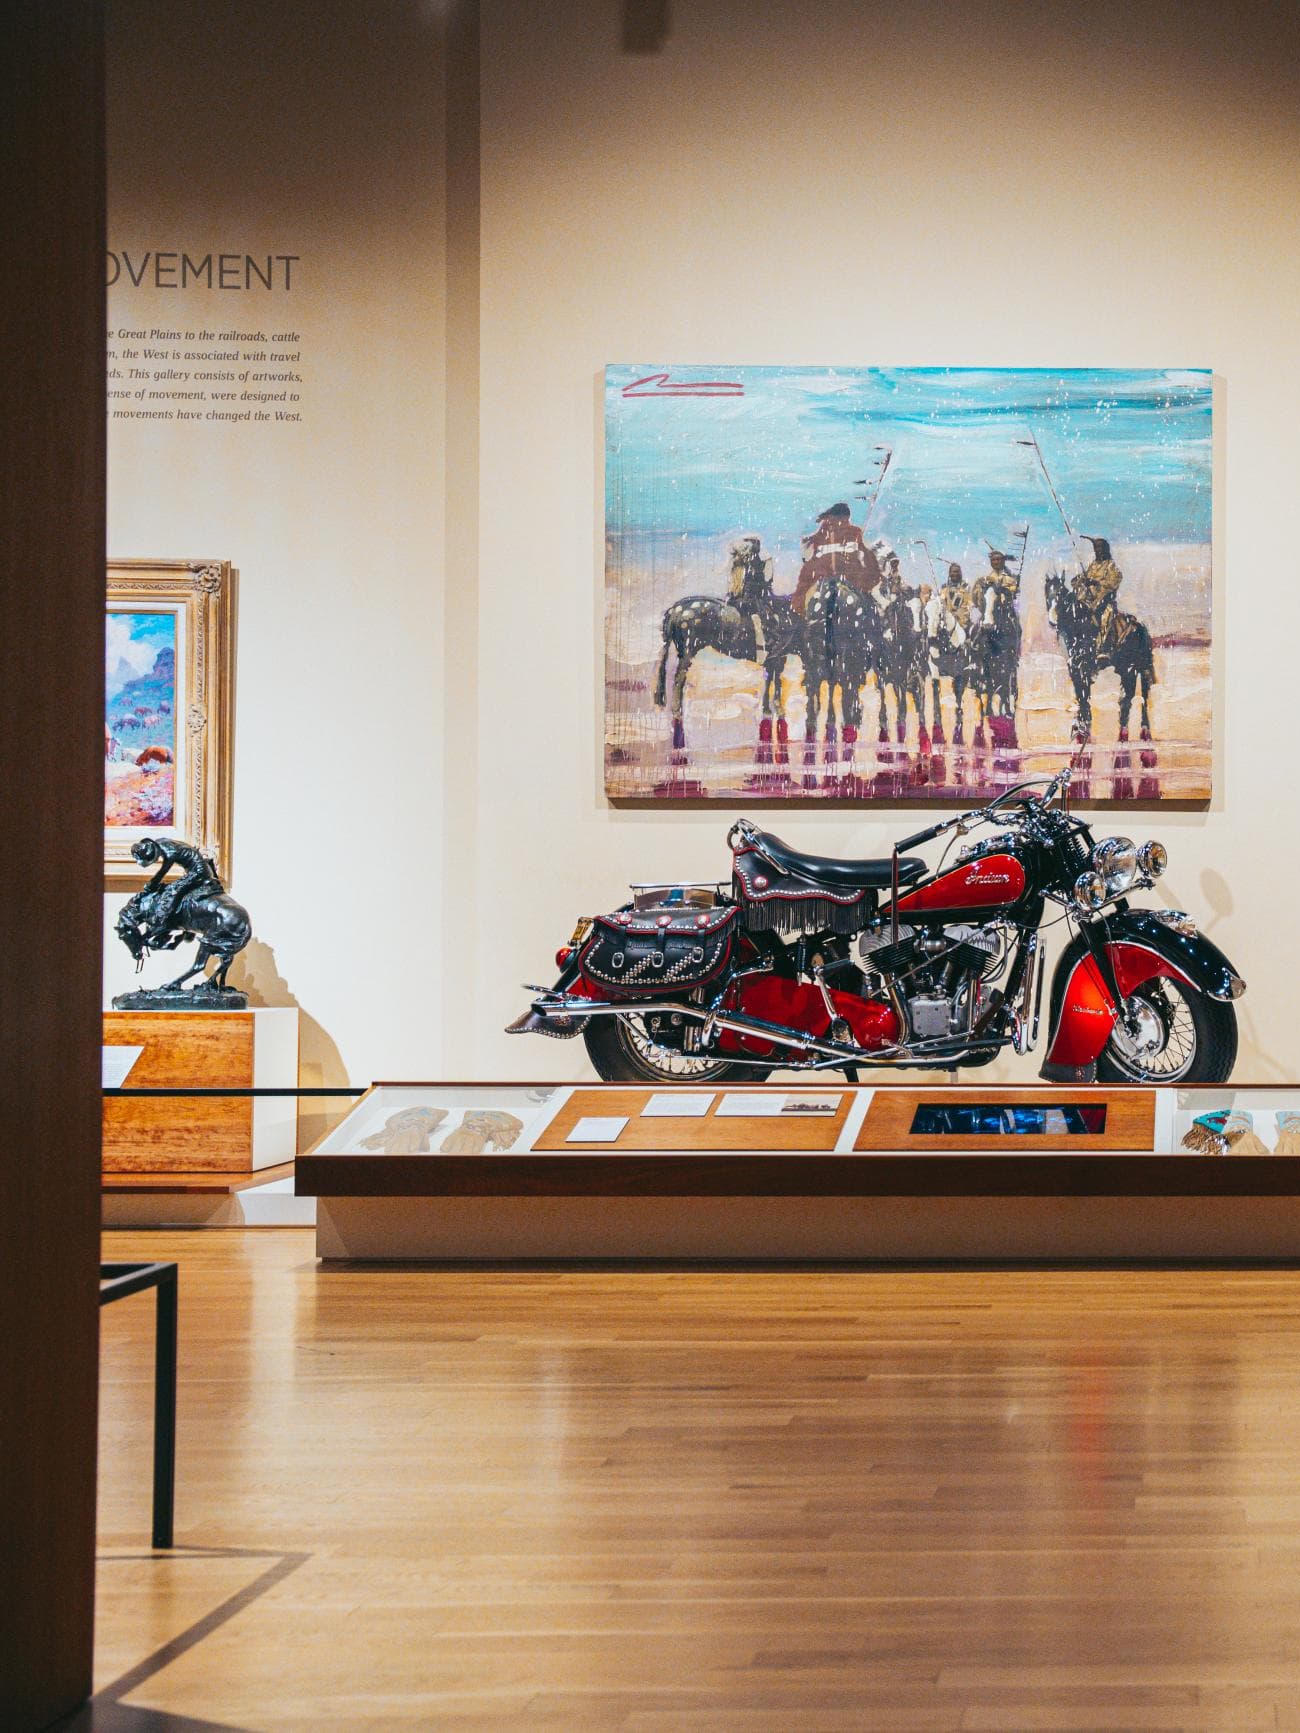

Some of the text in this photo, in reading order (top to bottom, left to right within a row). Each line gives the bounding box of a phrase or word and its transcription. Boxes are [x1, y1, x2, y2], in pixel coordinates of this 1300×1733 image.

[118, 329, 147, 339] Great
[150, 329, 181, 340] Plains
[185, 331, 195, 340] to
[199, 330, 215, 340] the
[218, 331, 268, 343] railroads,
[272, 332, 300, 342] cattle
[122, 348, 139, 359] the
[143, 349, 169, 360] West
[172, 350, 181, 360] is
[184, 350, 240, 361] associated
[243, 351, 267, 361] with
[270, 352, 301, 362] travel
[106, 368, 303, 384] ds. This gallery consists of artworks,
[135, 388, 146, 401] of
[149, 390, 206, 401] movement,
[211, 391, 237, 401] were
[240, 390, 287, 403] designed
[290, 392, 300, 402] to
[113, 409, 303, 423] movements have changed the West.
